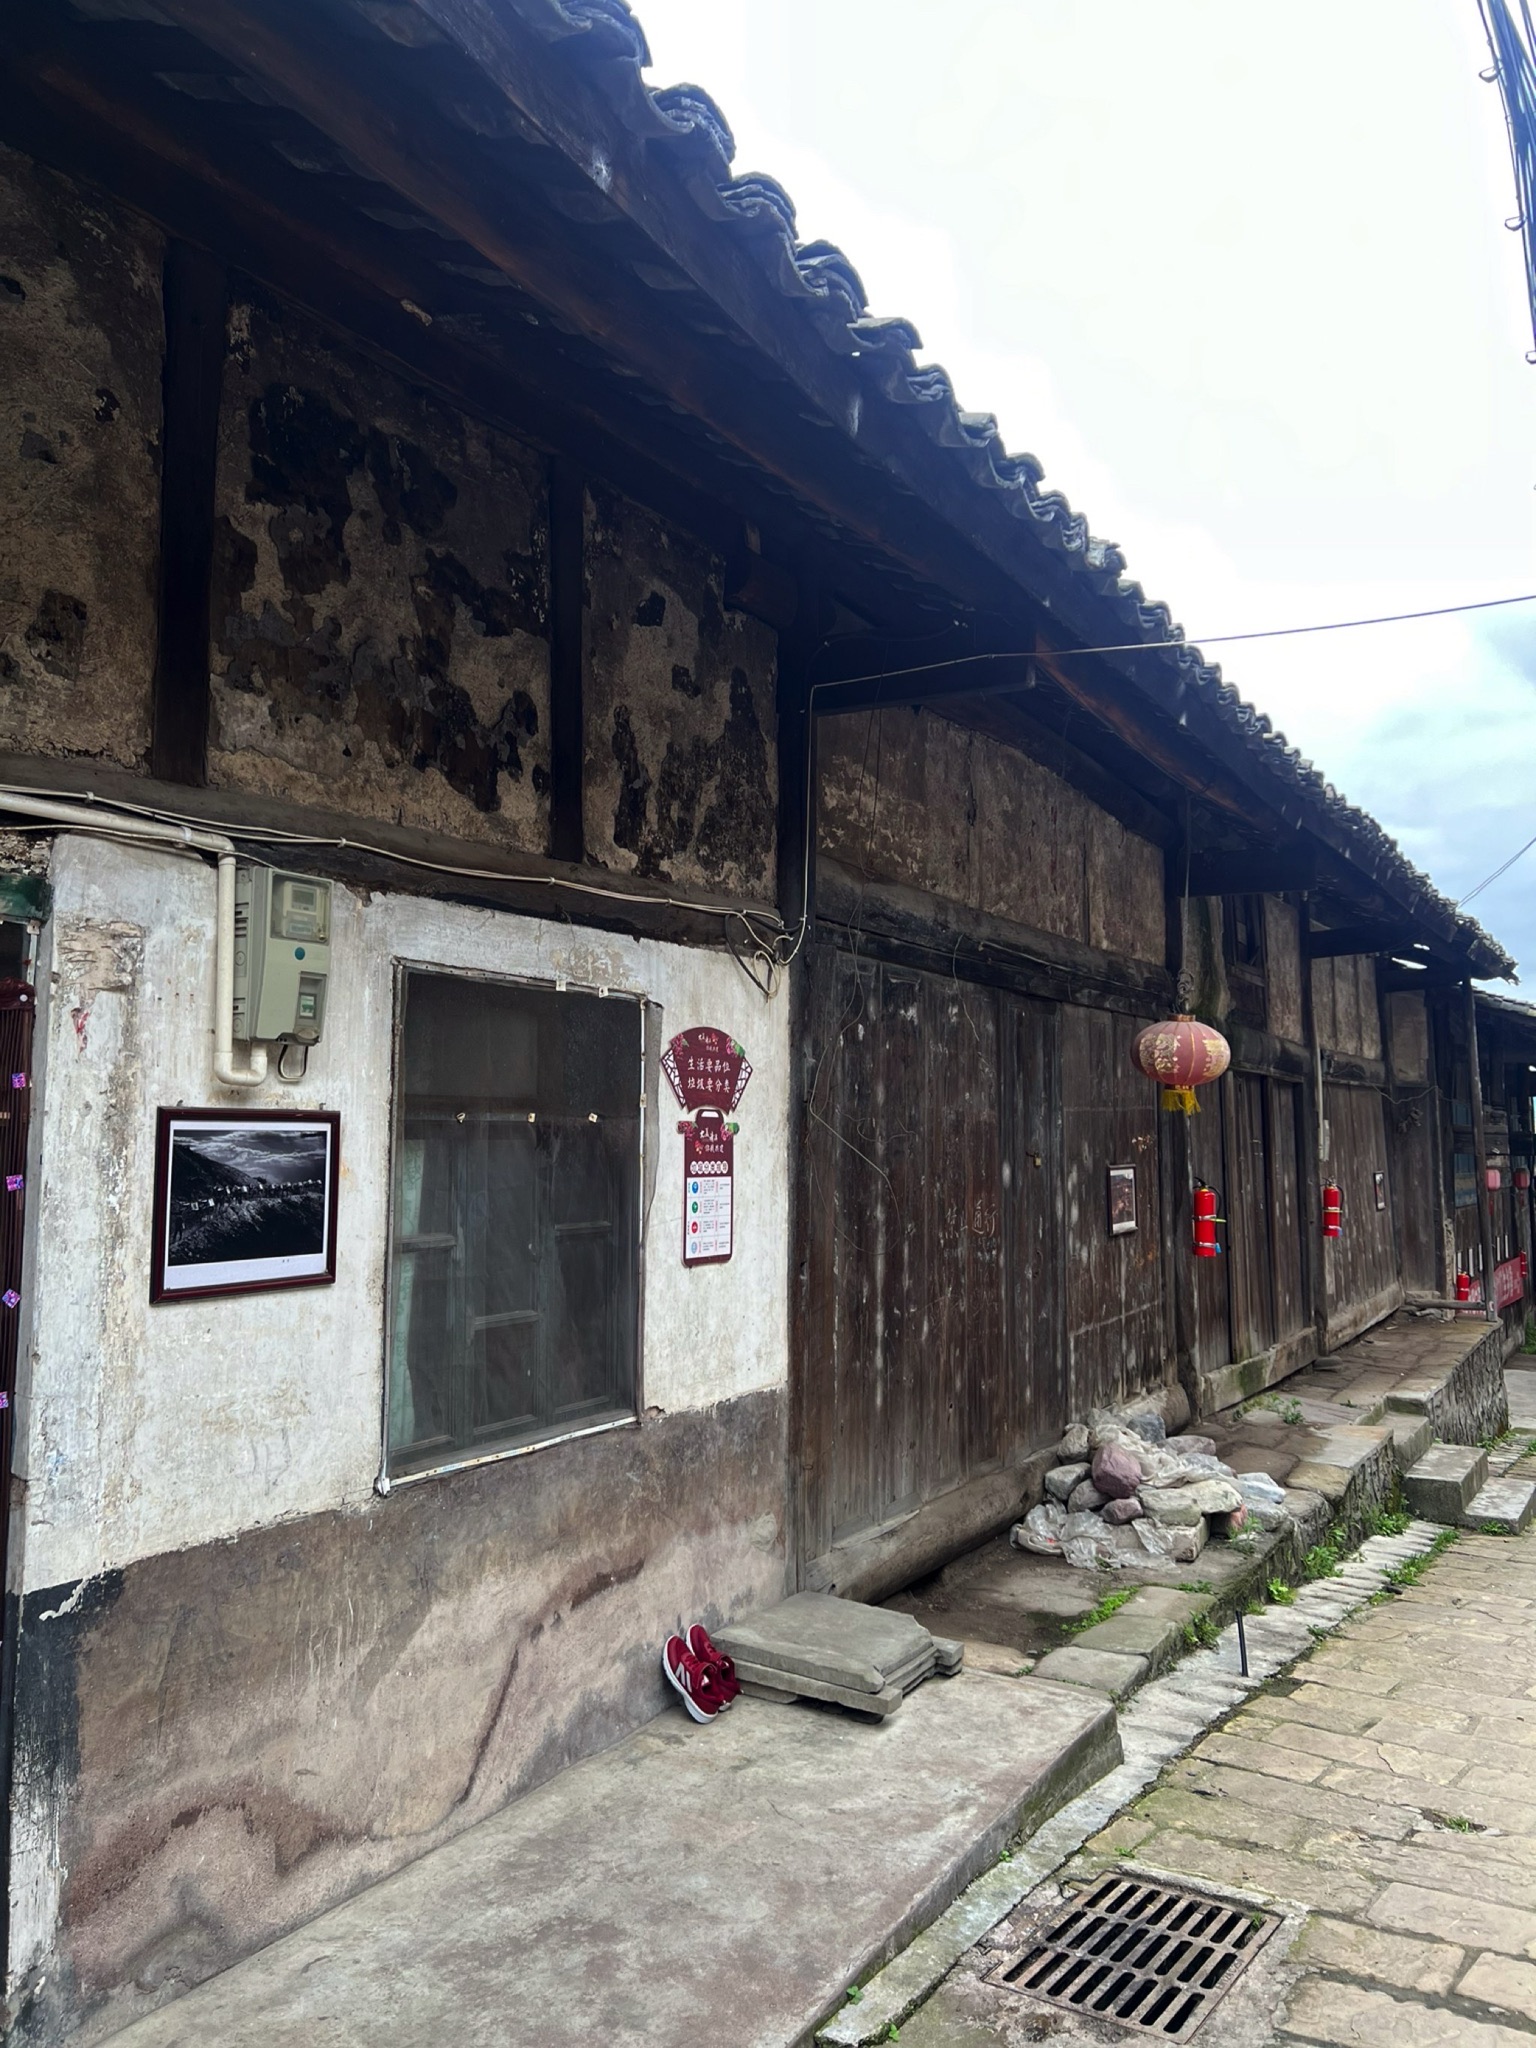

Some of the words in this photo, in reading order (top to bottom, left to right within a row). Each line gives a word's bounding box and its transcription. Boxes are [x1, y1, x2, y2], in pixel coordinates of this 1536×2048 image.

[688, 1056, 731, 1073] 生活要品位
